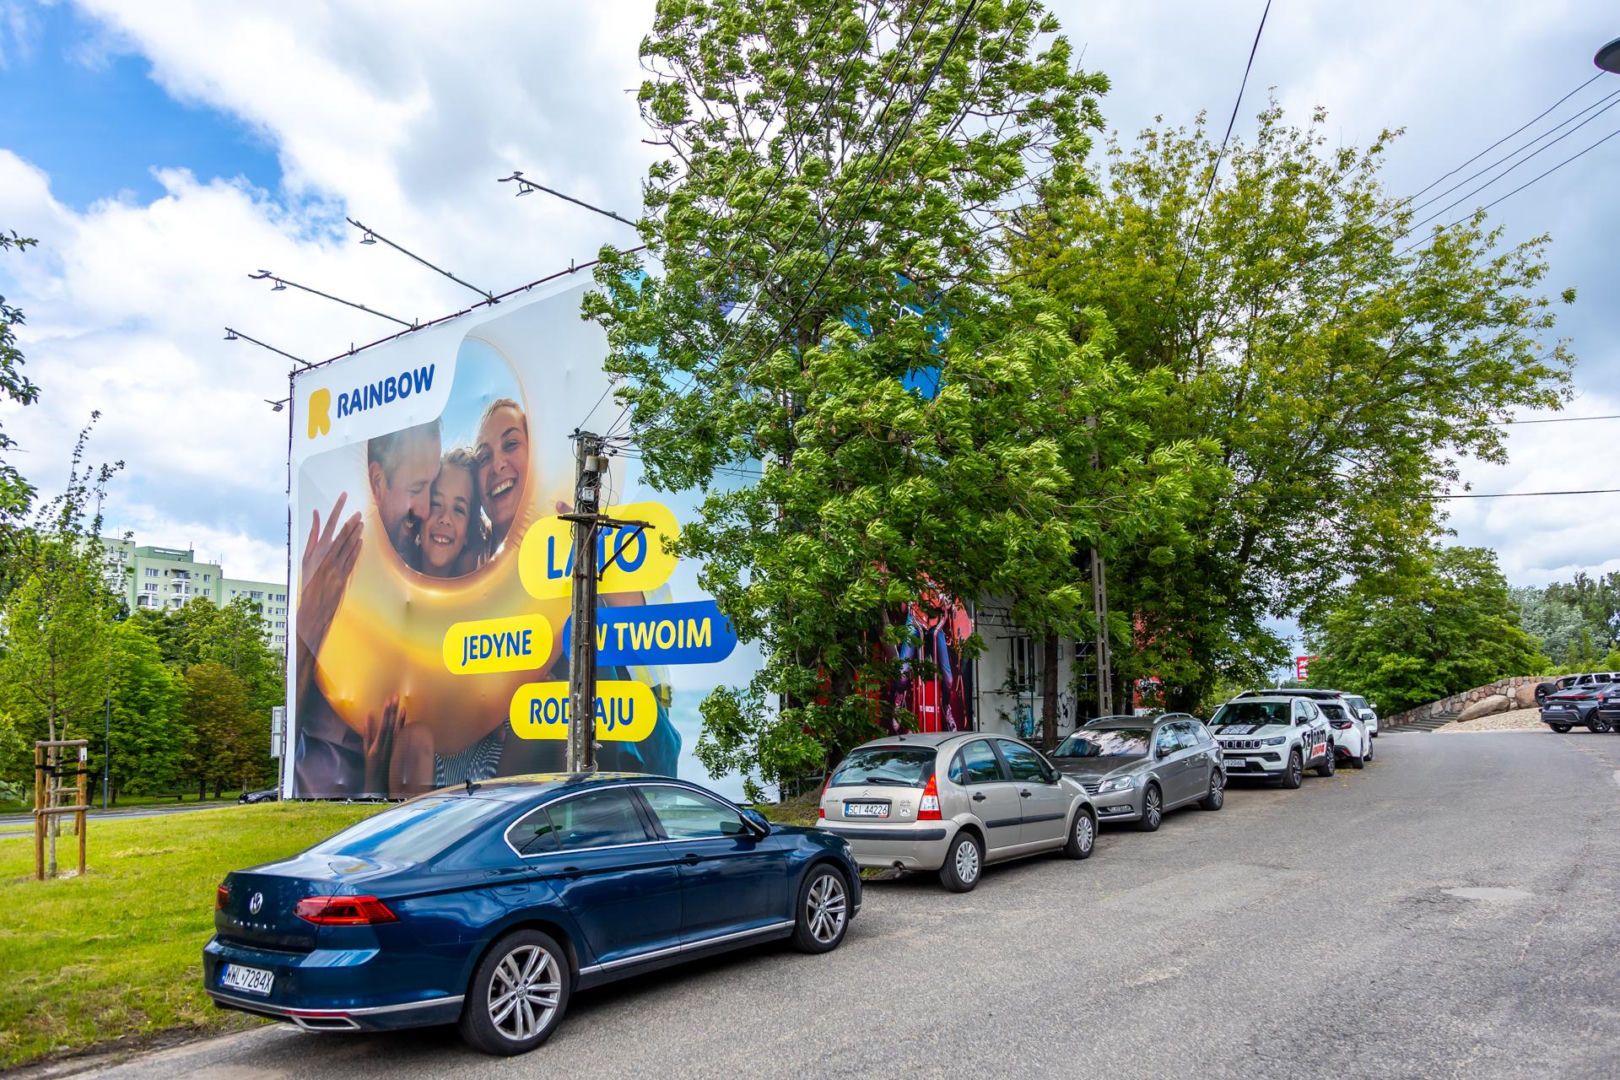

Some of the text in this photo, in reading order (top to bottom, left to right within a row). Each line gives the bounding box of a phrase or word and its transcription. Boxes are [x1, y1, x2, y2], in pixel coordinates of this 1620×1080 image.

[337, 363, 435, 419] RAINBOW
[547, 524, 648, 580] LTO
[461, 629, 532, 667] JEDYNE
[614, 617, 712, 651] TWOIM
[529, 697, 634, 732] RODAJU
[864, 804, 888, 815] 44226
[243, 969, 274, 992] 7284X
